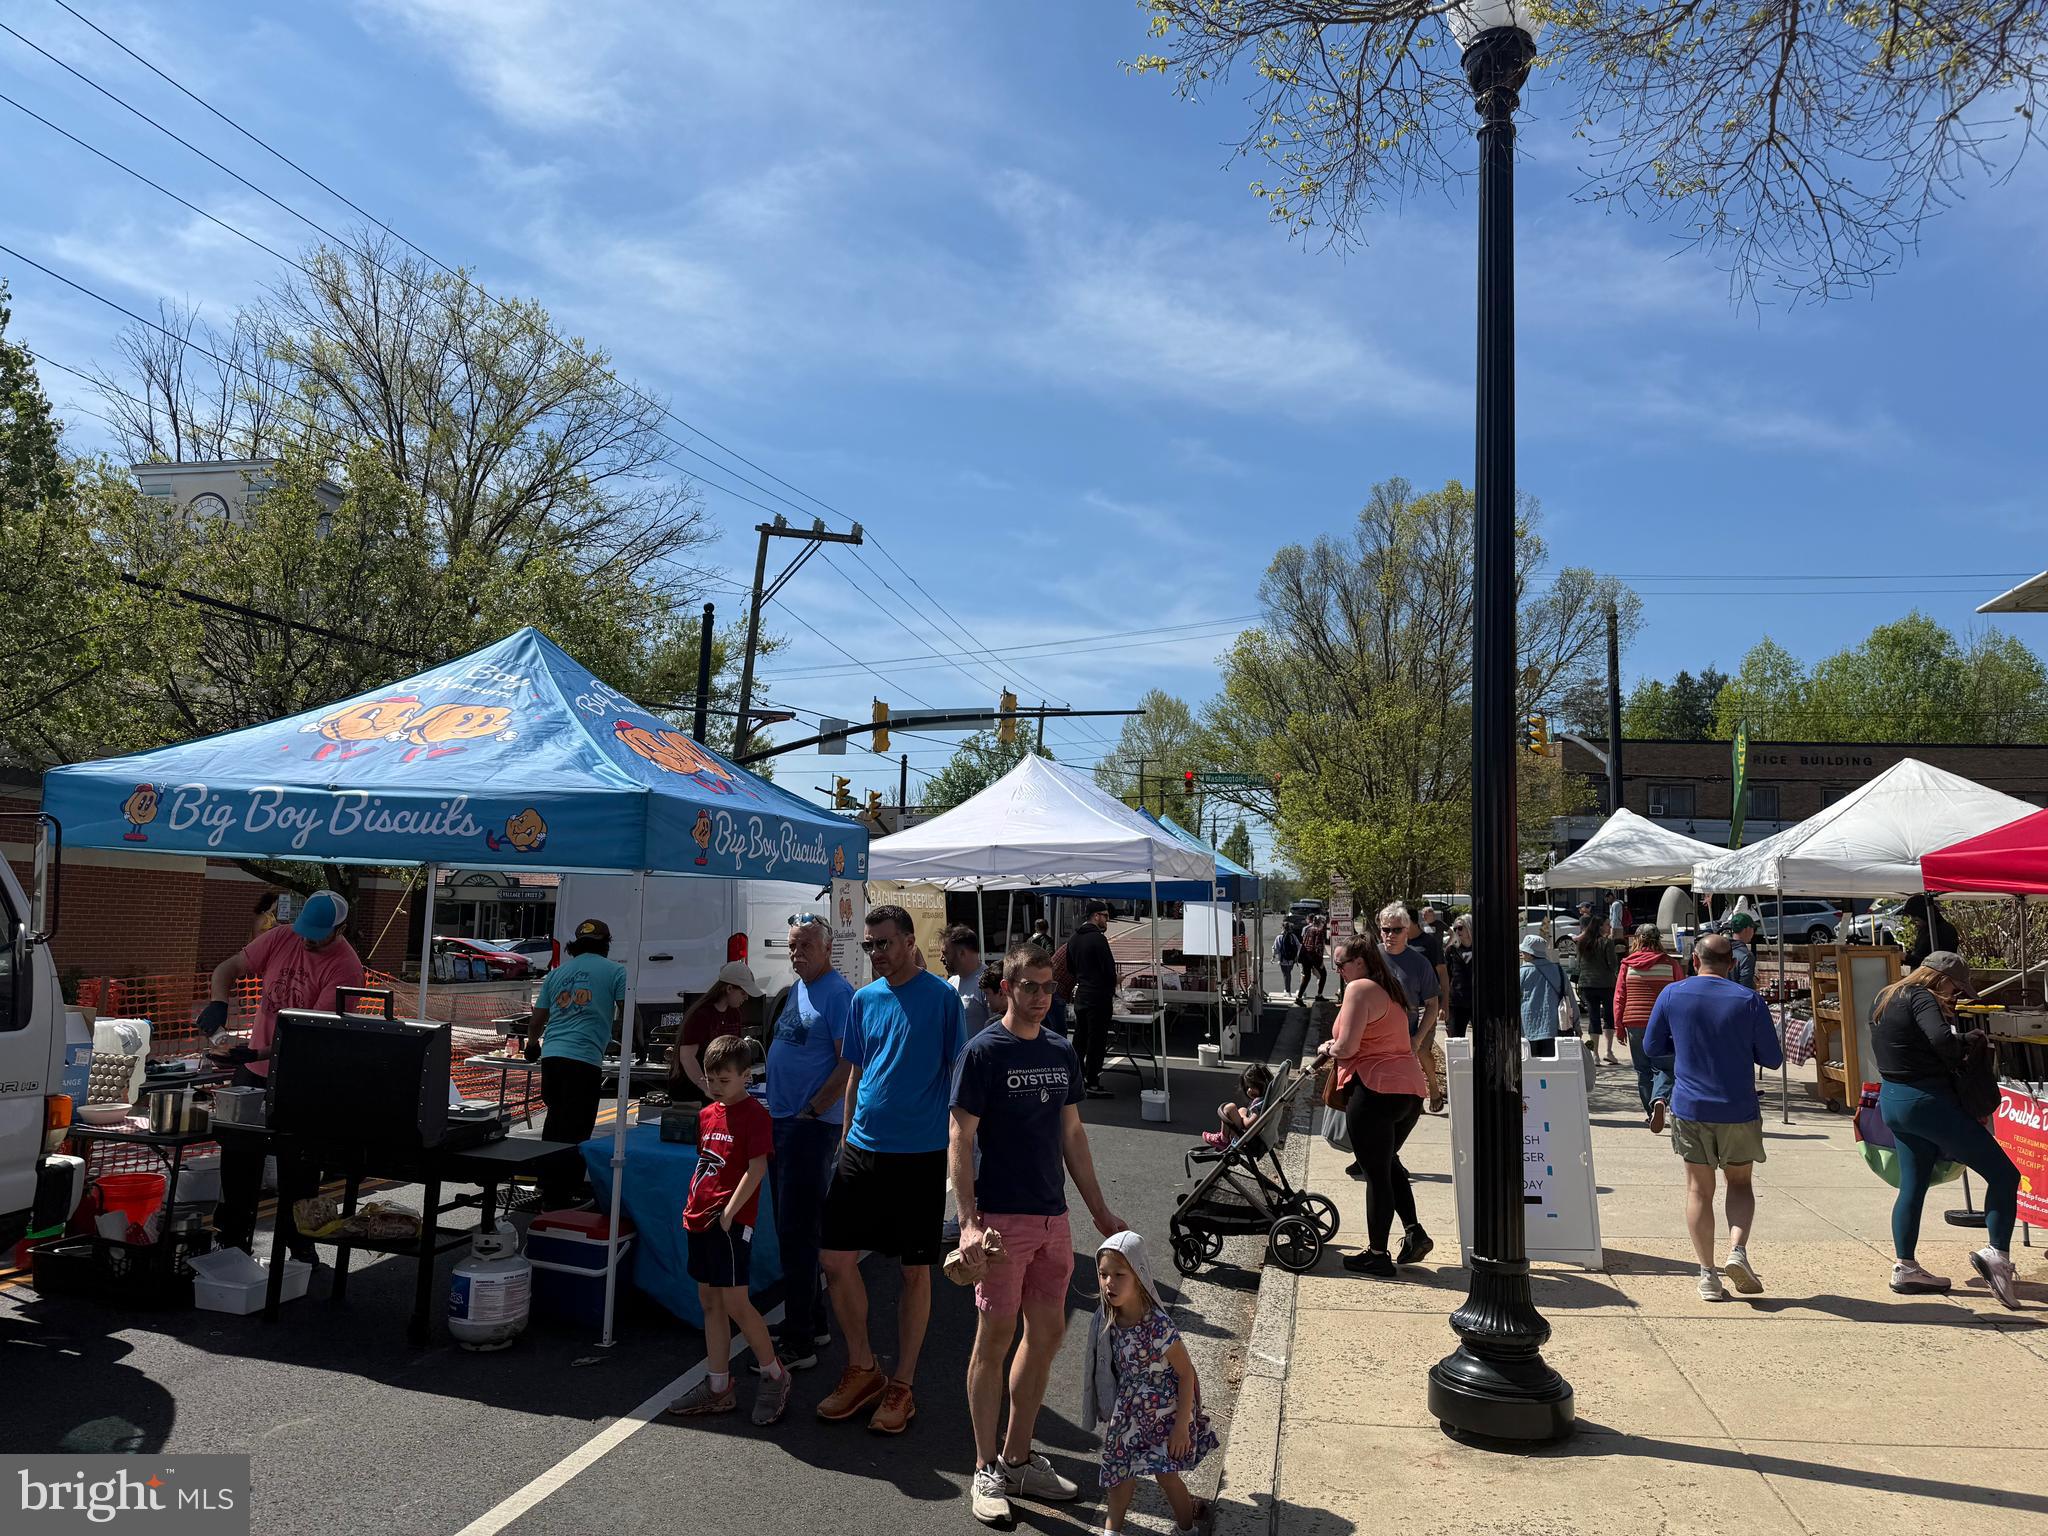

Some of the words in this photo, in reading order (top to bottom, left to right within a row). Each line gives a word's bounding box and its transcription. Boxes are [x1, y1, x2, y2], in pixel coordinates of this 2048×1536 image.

[466, 664, 531, 689] Boy
[1753, 755, 1787, 765] RICE
[1800, 756, 1873, 766] BUILDING
[1205, 774, 1244, 784] Washington
[168, 783, 237, 847] Big
[244, 785, 323, 849] Boy
[328, 790, 483, 837] Biscuits
[714, 810, 748, 871] Big
[748, 816, 780, 873] Boy
[779, 821, 829, 866] Biscuits
[870, 890, 911, 908] BAGUETTE
[912, 892, 945, 909] REPUBLIC
[1007, 1067, 1051, 1075] RAPPAHANNOCK
[20, 1080, 39, 1091] HD
[1007, 1072, 1069, 1088] OYSTERS
[1998, 1095, 2041, 1130] Double
[703, 1132, 734, 1143] CONS
